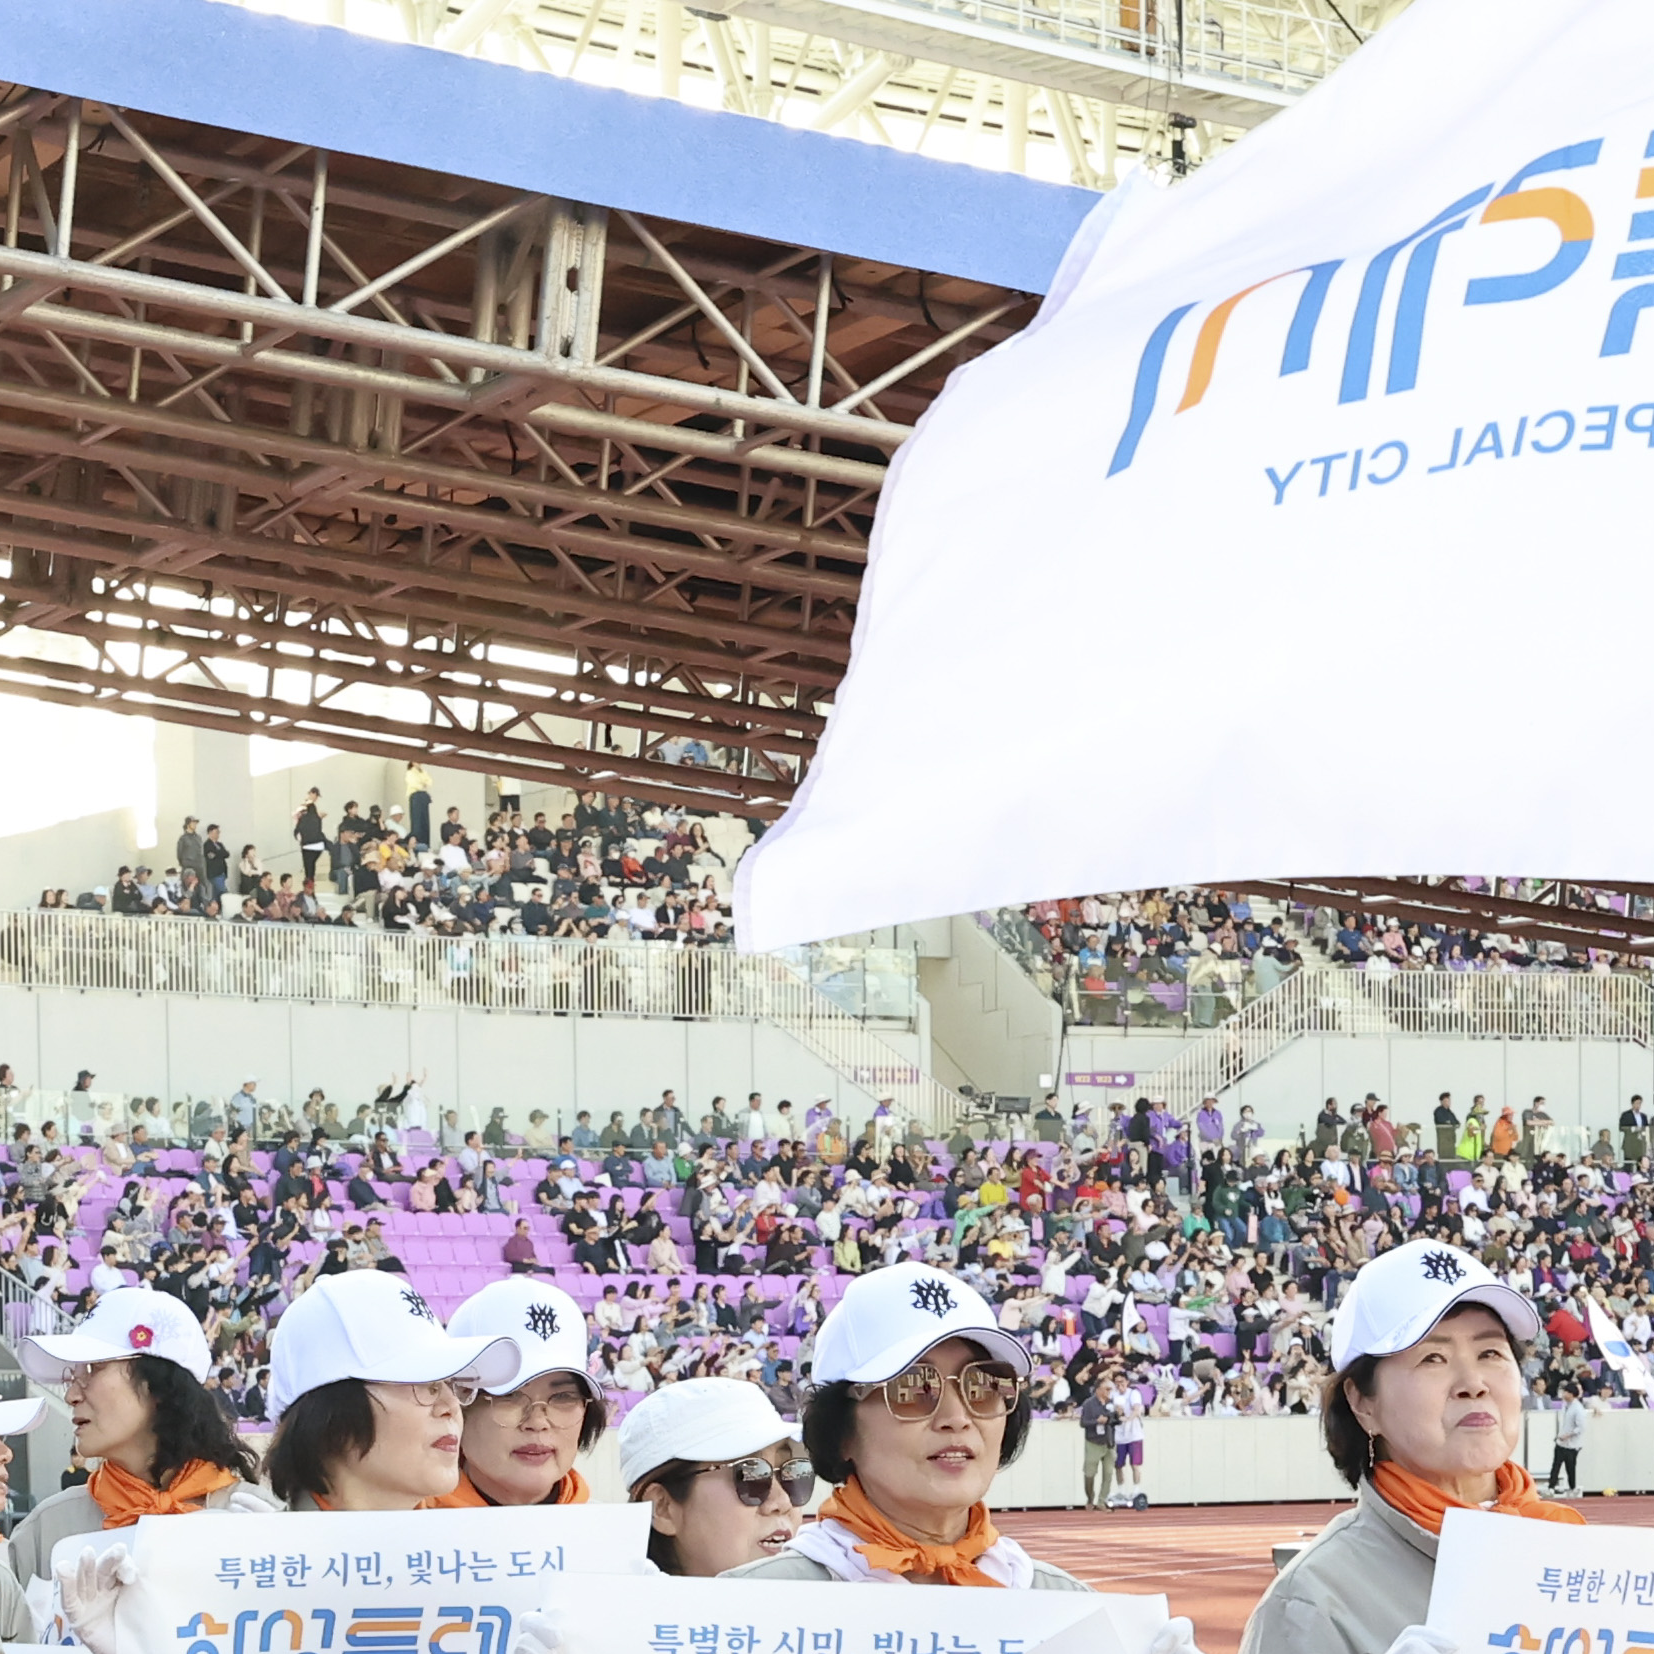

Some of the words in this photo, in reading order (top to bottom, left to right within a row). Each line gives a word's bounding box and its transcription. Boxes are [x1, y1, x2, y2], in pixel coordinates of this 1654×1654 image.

[216, 1554, 313, 1589] 특별한
[323, 1551, 395, 1587] 시민,
[407, 1548, 499, 1584] 빛나는
[507, 1545, 564, 1578] 도시
[1537, 1567, 1606, 1605] 특별한
